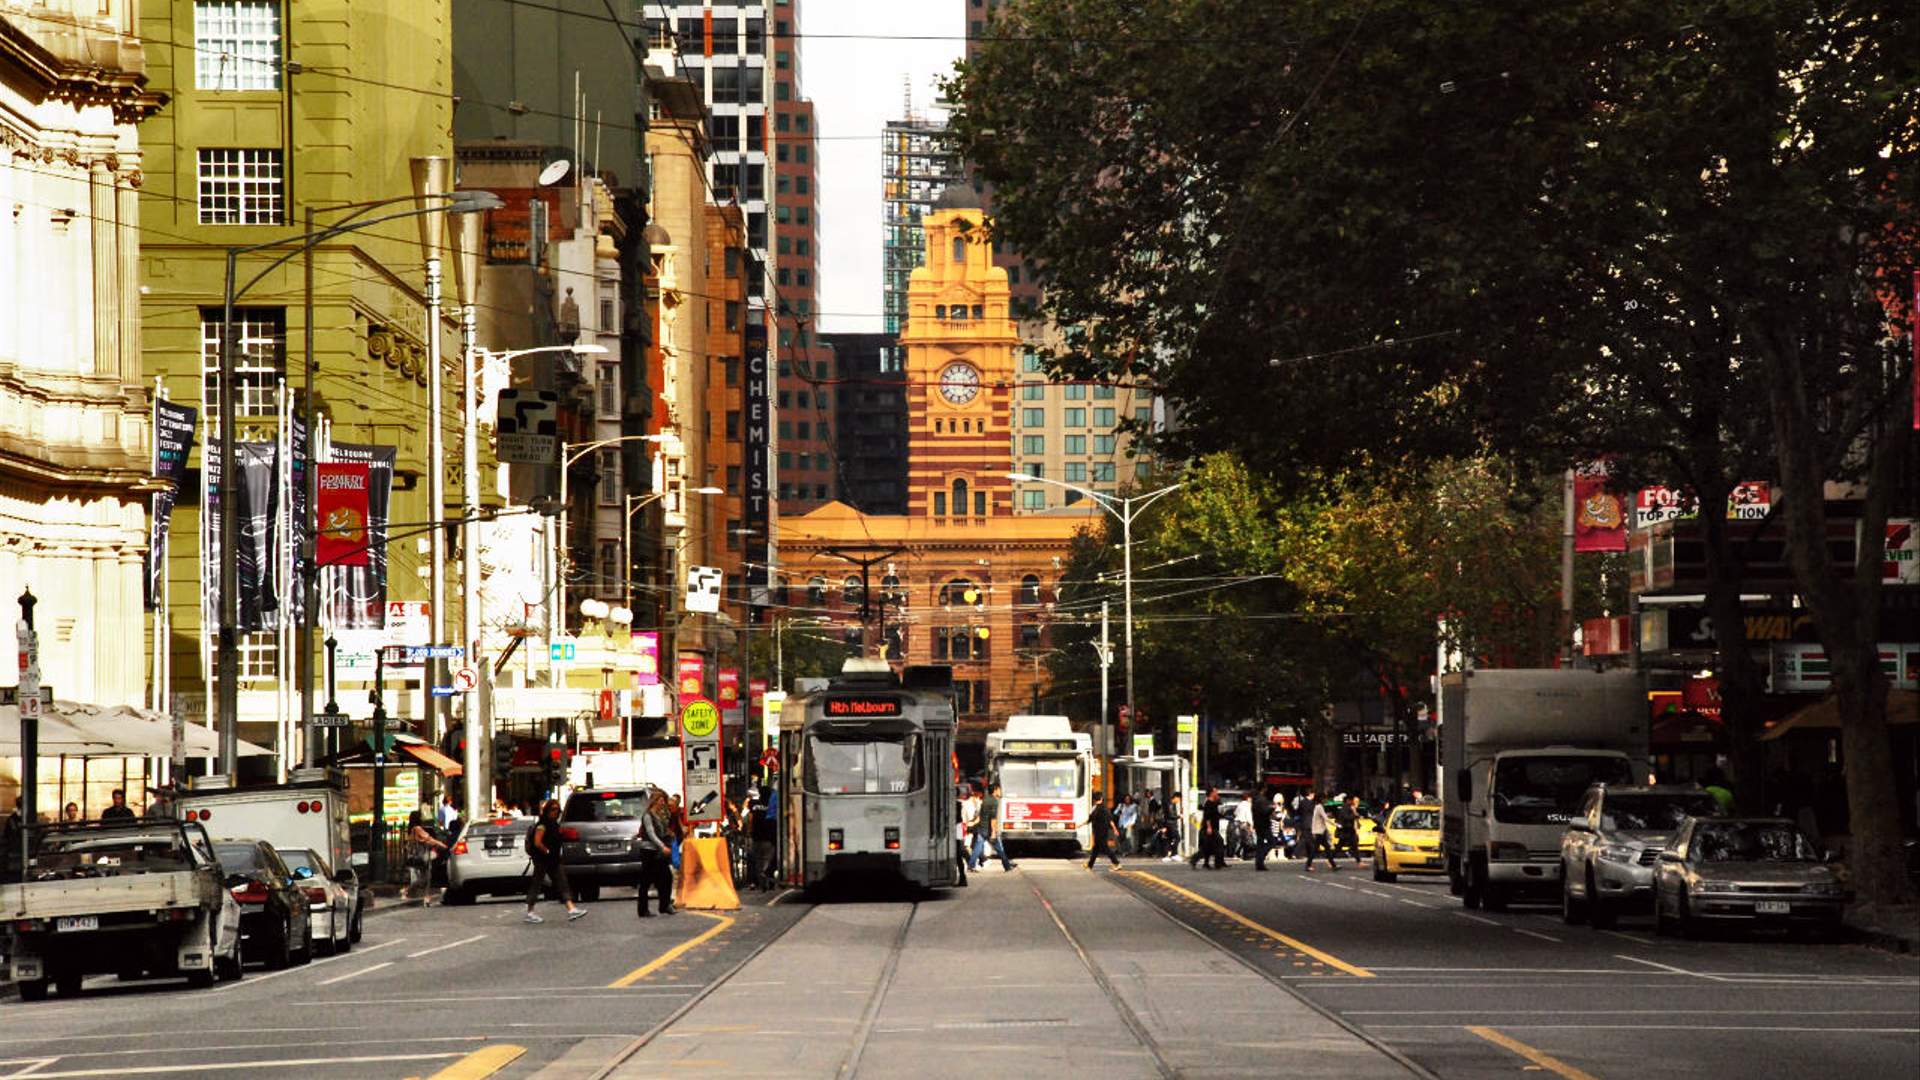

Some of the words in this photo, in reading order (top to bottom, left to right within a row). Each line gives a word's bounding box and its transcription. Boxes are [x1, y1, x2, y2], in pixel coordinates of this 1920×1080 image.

[750, 357, 763, 512] CHEMIST
[320, 475, 364, 483] COMEDY
[320, 481, 366, 490] FESTIVAL
[1638, 511, 1664, 522] TOP
[687, 708, 713, 719] SAFETY
[691, 720, 709, 730] ZONE
